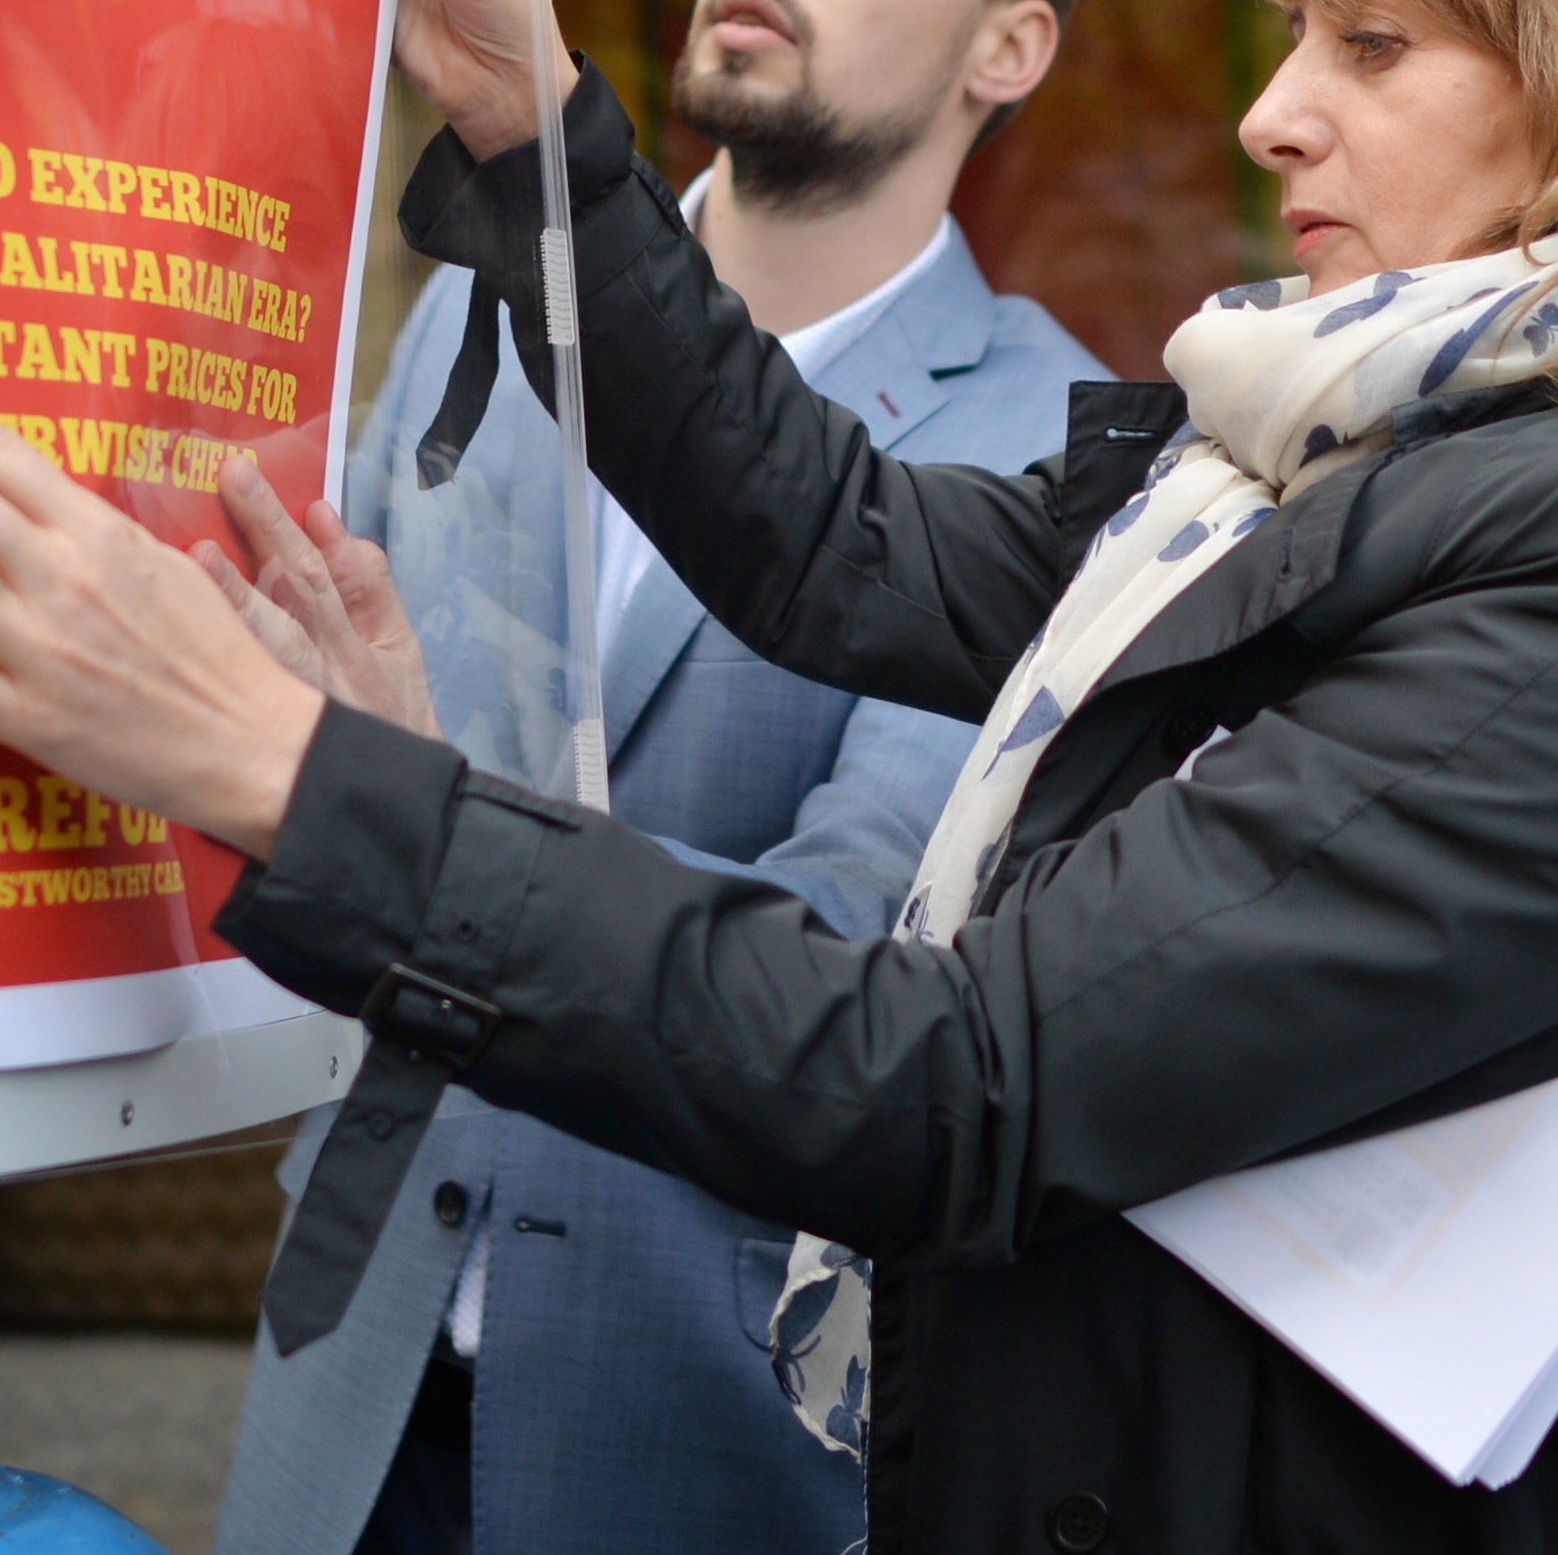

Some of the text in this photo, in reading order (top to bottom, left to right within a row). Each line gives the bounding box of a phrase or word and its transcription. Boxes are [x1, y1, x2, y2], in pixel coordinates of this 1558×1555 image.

[28, 148, 291, 253] EXPERIENCE
[247, 278, 312, 343] ERA?
[145, 338, 248, 412] PRICES
[246, 364, 298, 425] FOR
